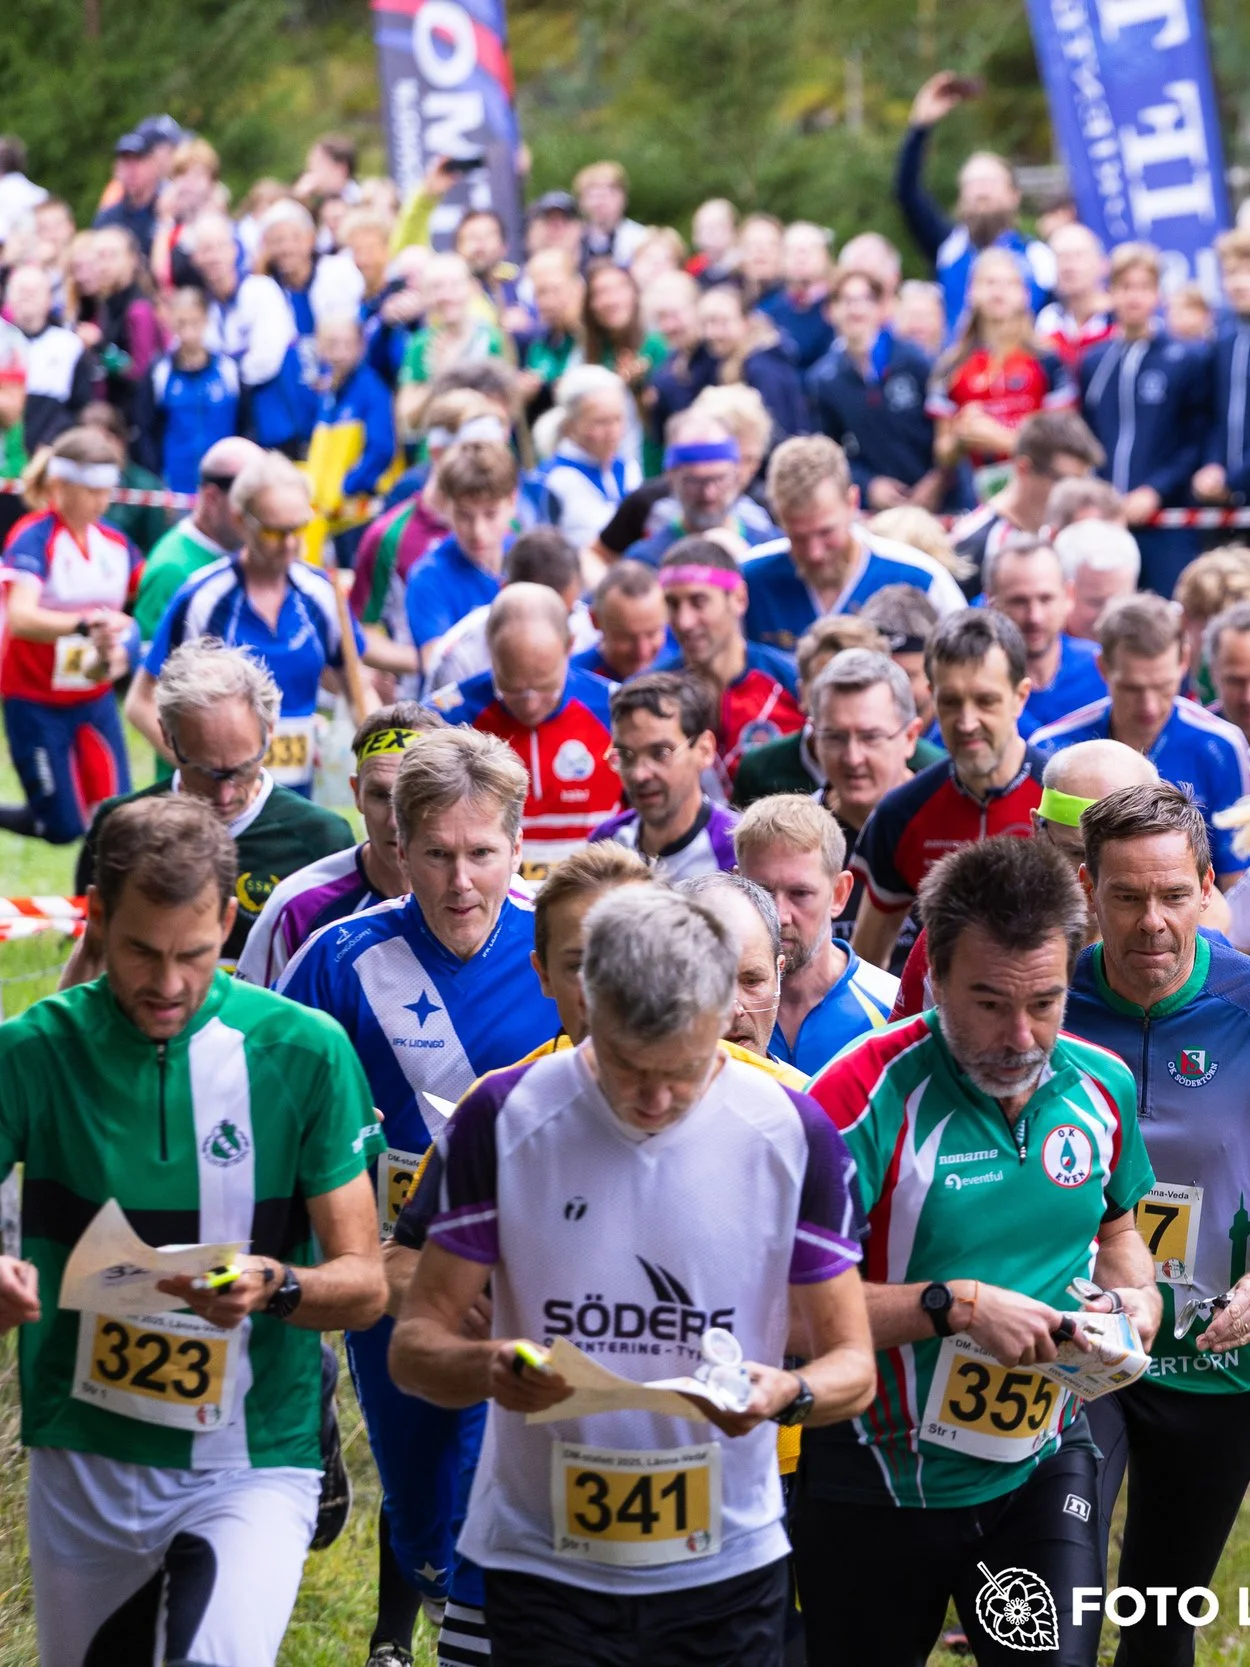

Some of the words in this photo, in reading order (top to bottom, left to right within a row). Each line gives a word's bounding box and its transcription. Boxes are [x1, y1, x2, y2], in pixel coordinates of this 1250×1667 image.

[393, 1038, 409, 1047] IFK
[409, 1038, 444, 1049] LIDINGÖ
[1168, 1061, 1177, 1075] OK
[1174, 1062, 1218, 1087] SÖDERTÖRN
[938, 1149, 999, 1165] noname
[961, 1170, 1004, 1187] eventful
[543, 1293, 735, 1343] SÖDERS
[96, 1322, 211, 1398] 323
[949, 1362, 1054, 1432] 355
[927, 1424, 948, 1437] Str
[950, 1430, 957, 1440] 1
[574, 1471, 688, 1534] 341
